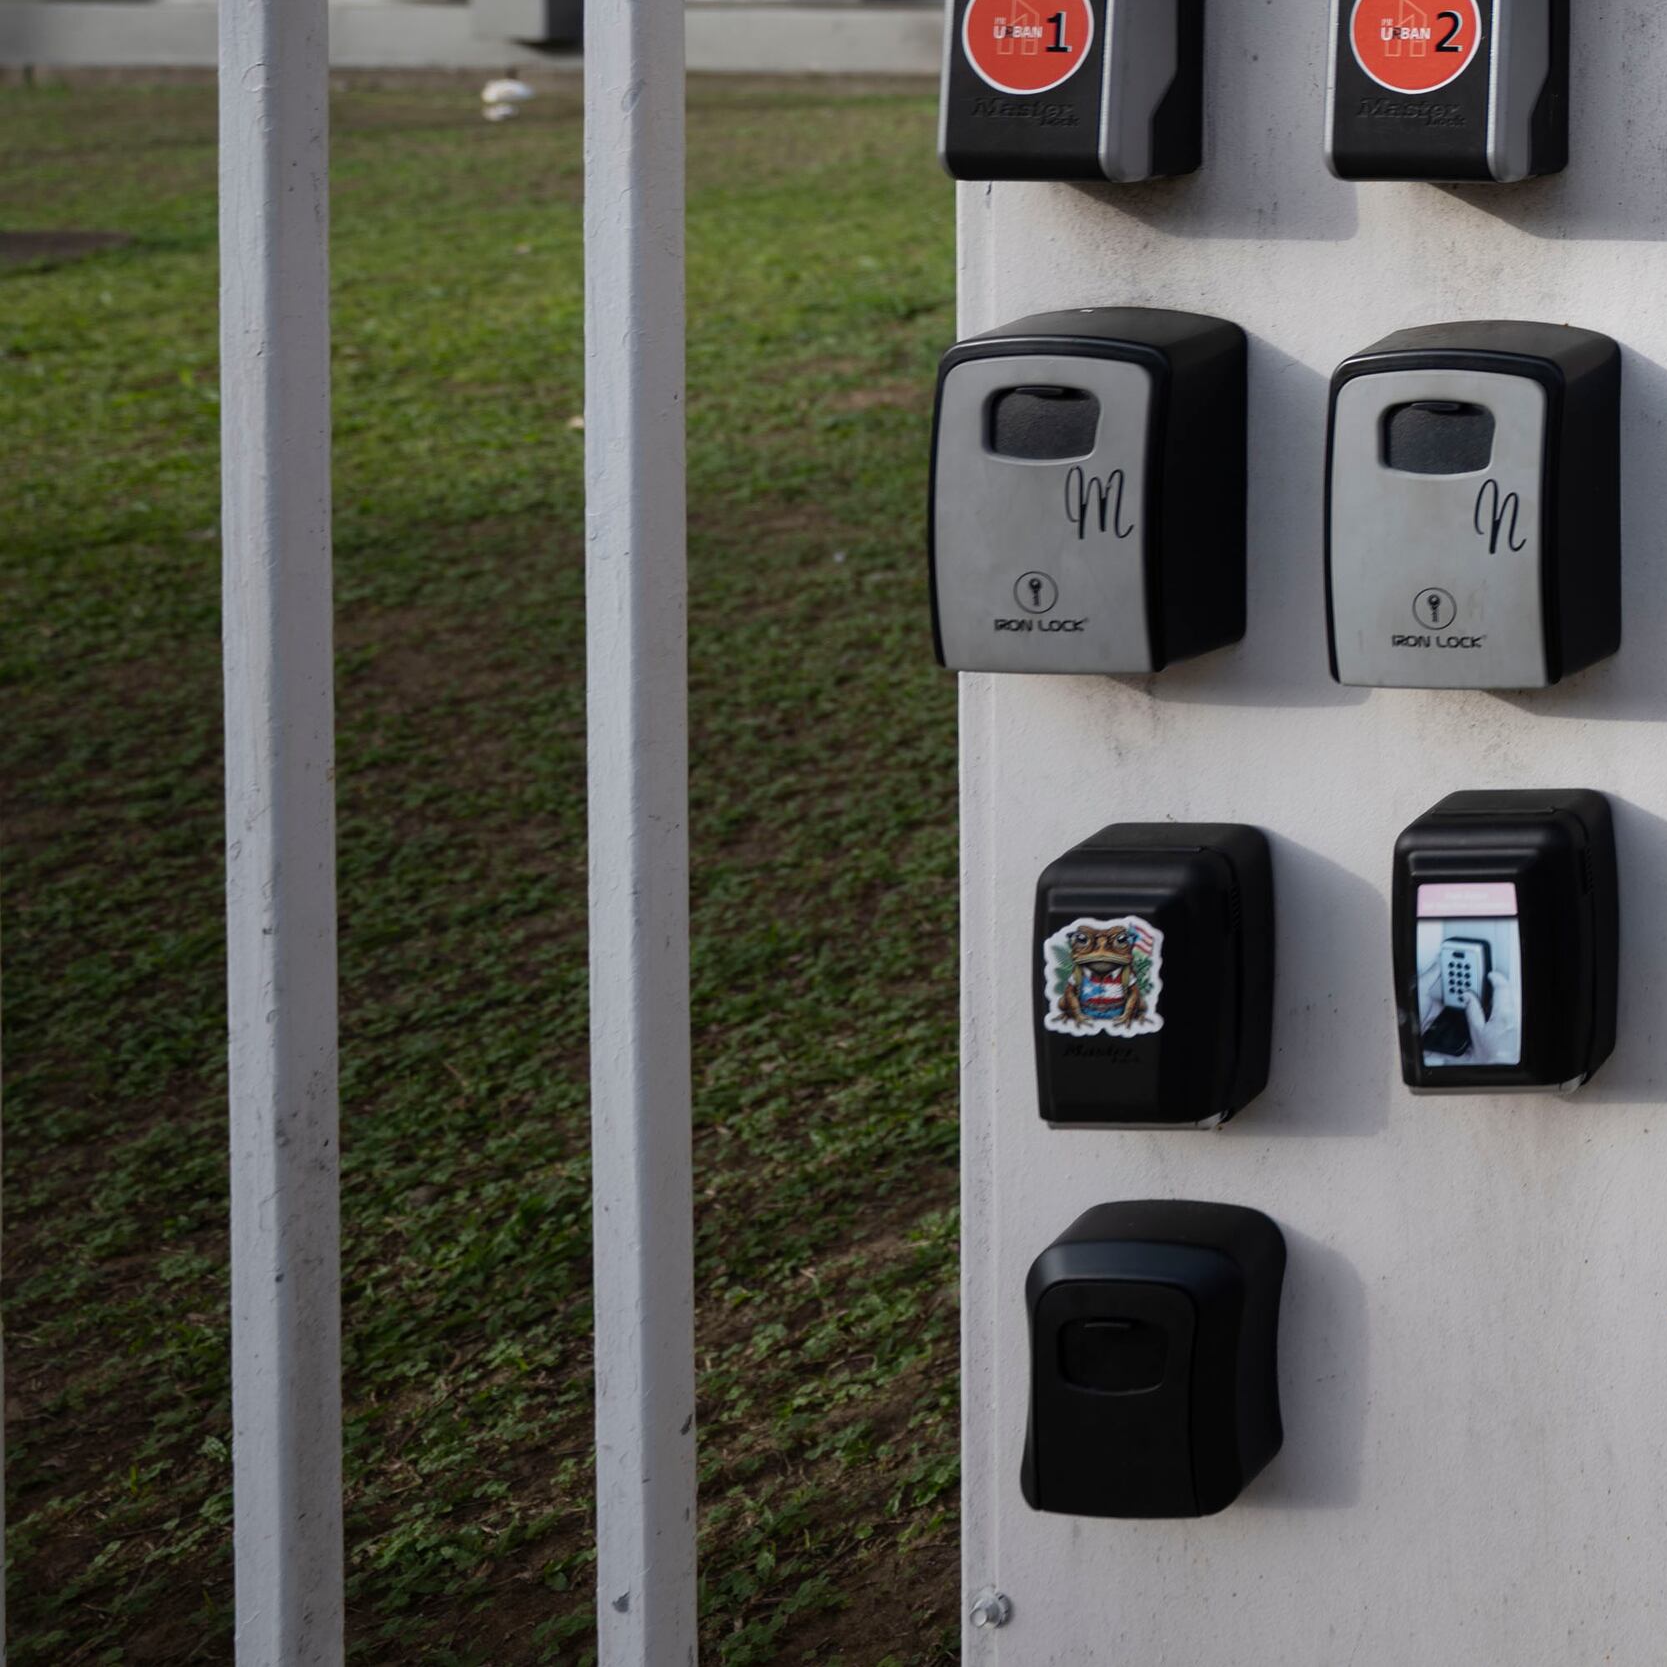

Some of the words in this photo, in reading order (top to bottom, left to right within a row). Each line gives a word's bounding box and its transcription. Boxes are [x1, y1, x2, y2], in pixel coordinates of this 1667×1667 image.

[993, 26, 1043, 40] URBAN
[1046, 10, 1073, 53] 1
[1380, 27, 1431, 41] URBAN
[1435, 10, 1464, 53] 2
[972, 97, 1075, 117] Master
[1358, 97, 1463, 117] Master
[993, 618, 1033, 631] IRON
[1038, 619, 1084, 632] LOCK
[1391, 635, 1430, 647] IRON
[1436, 635, 1482, 648] LOCK
